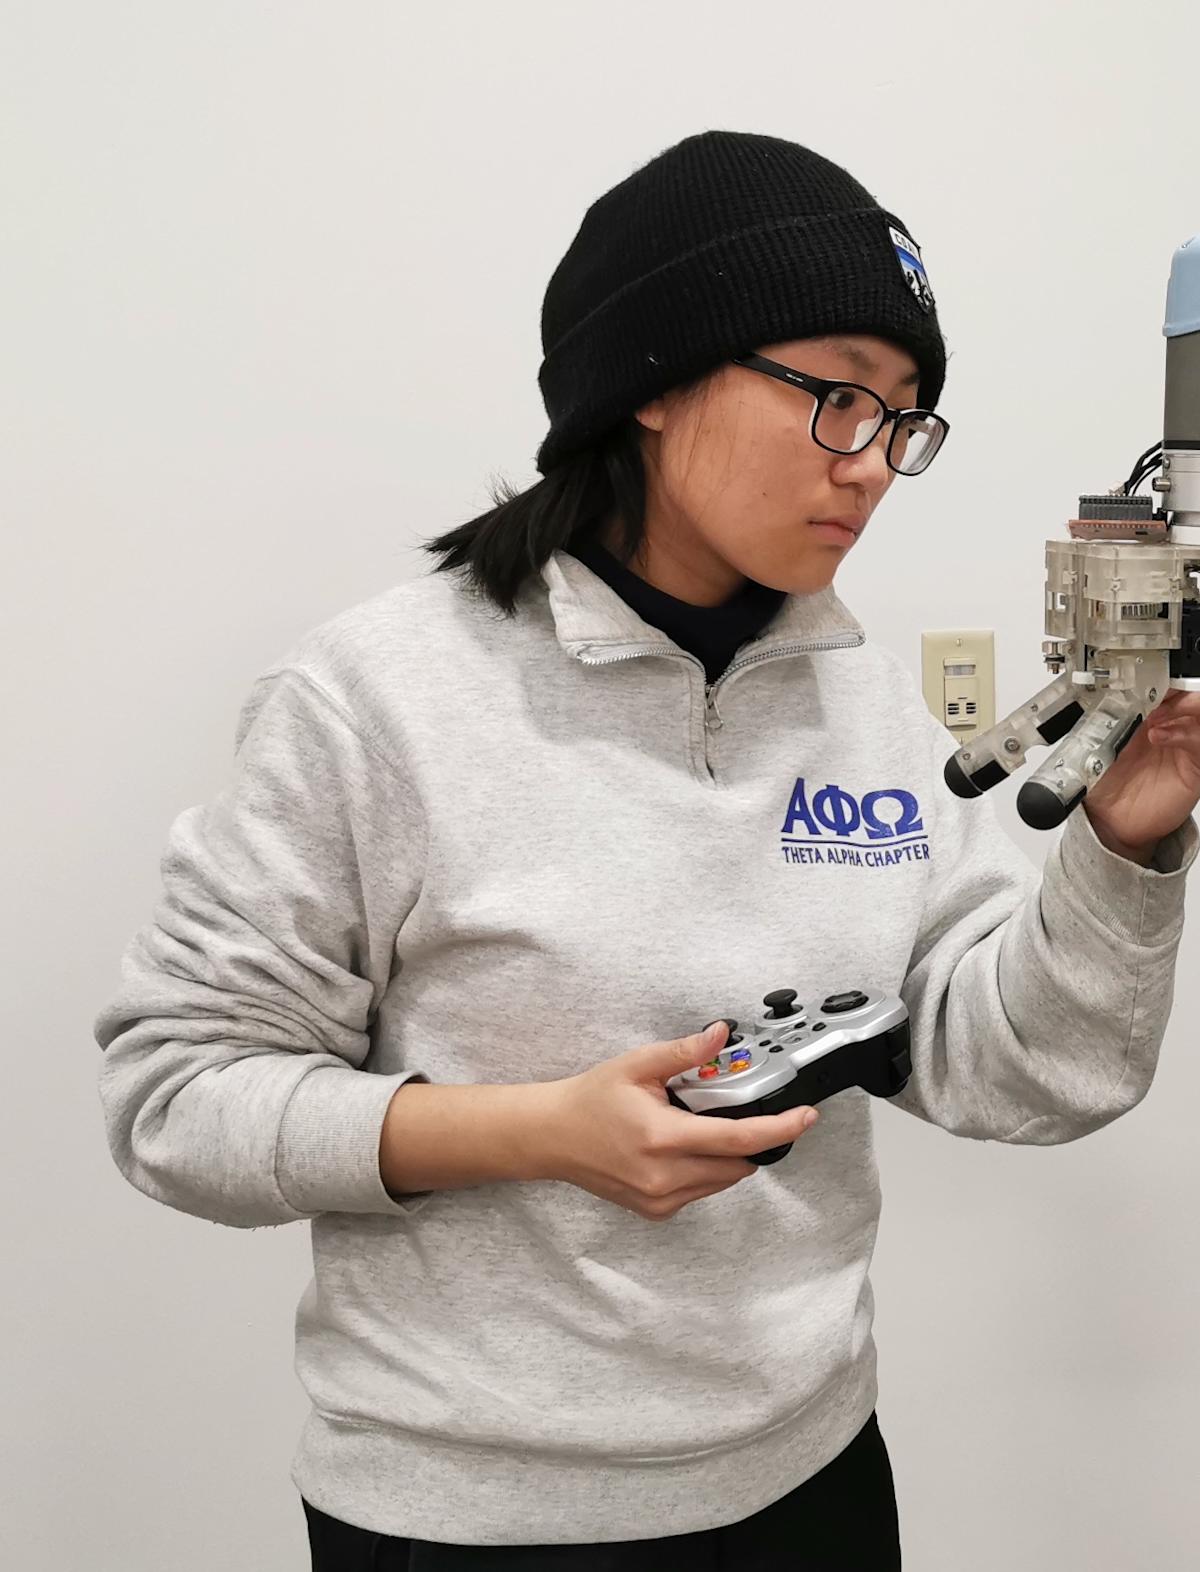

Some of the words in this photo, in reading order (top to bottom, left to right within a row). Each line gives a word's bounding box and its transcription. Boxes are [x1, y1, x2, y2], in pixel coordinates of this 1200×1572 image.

[782, 846, 824, 864] THETA
[827, 848, 863, 867] ALPHA
[865, 843, 930, 867] CHAPTER
